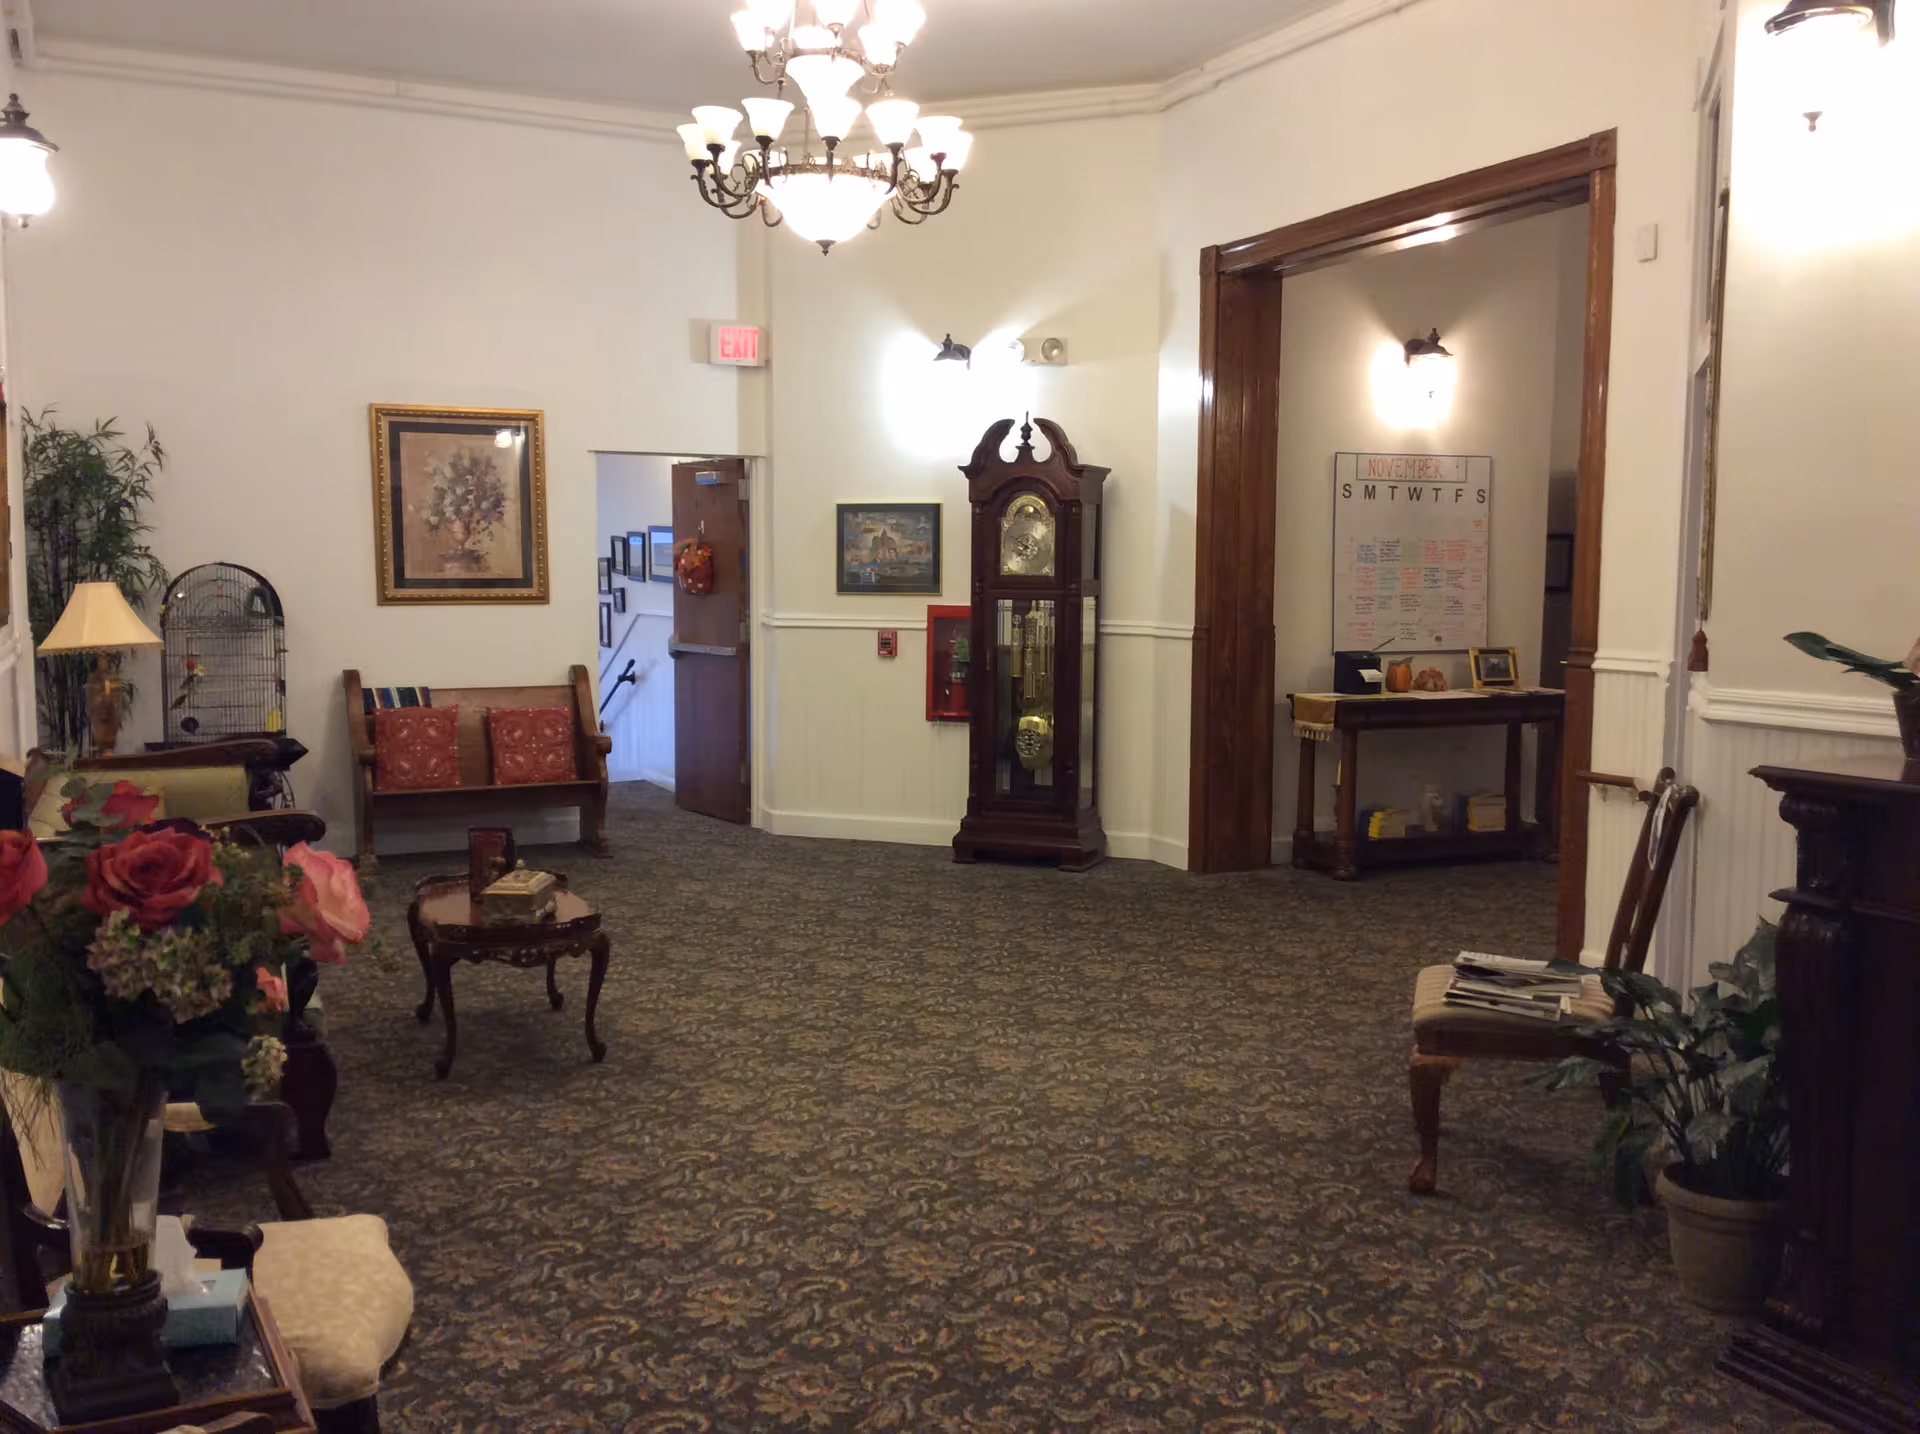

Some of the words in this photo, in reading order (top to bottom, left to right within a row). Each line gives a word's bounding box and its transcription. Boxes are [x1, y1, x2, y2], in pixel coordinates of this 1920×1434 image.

[720, 327, 759, 359] EXIT
[1368, 457, 1443, 479] NOVEMBER
[1342, 483, 1352, 499] S
[1364, 485, 1376, 500] M
[1388, 486, 1398, 501] T
[1408, 487, 1423, 502] W
[1432, 488, 1441, 502] T
[1455, 489, 1464, 503] F
[1476, 489, 1486, 504] S
